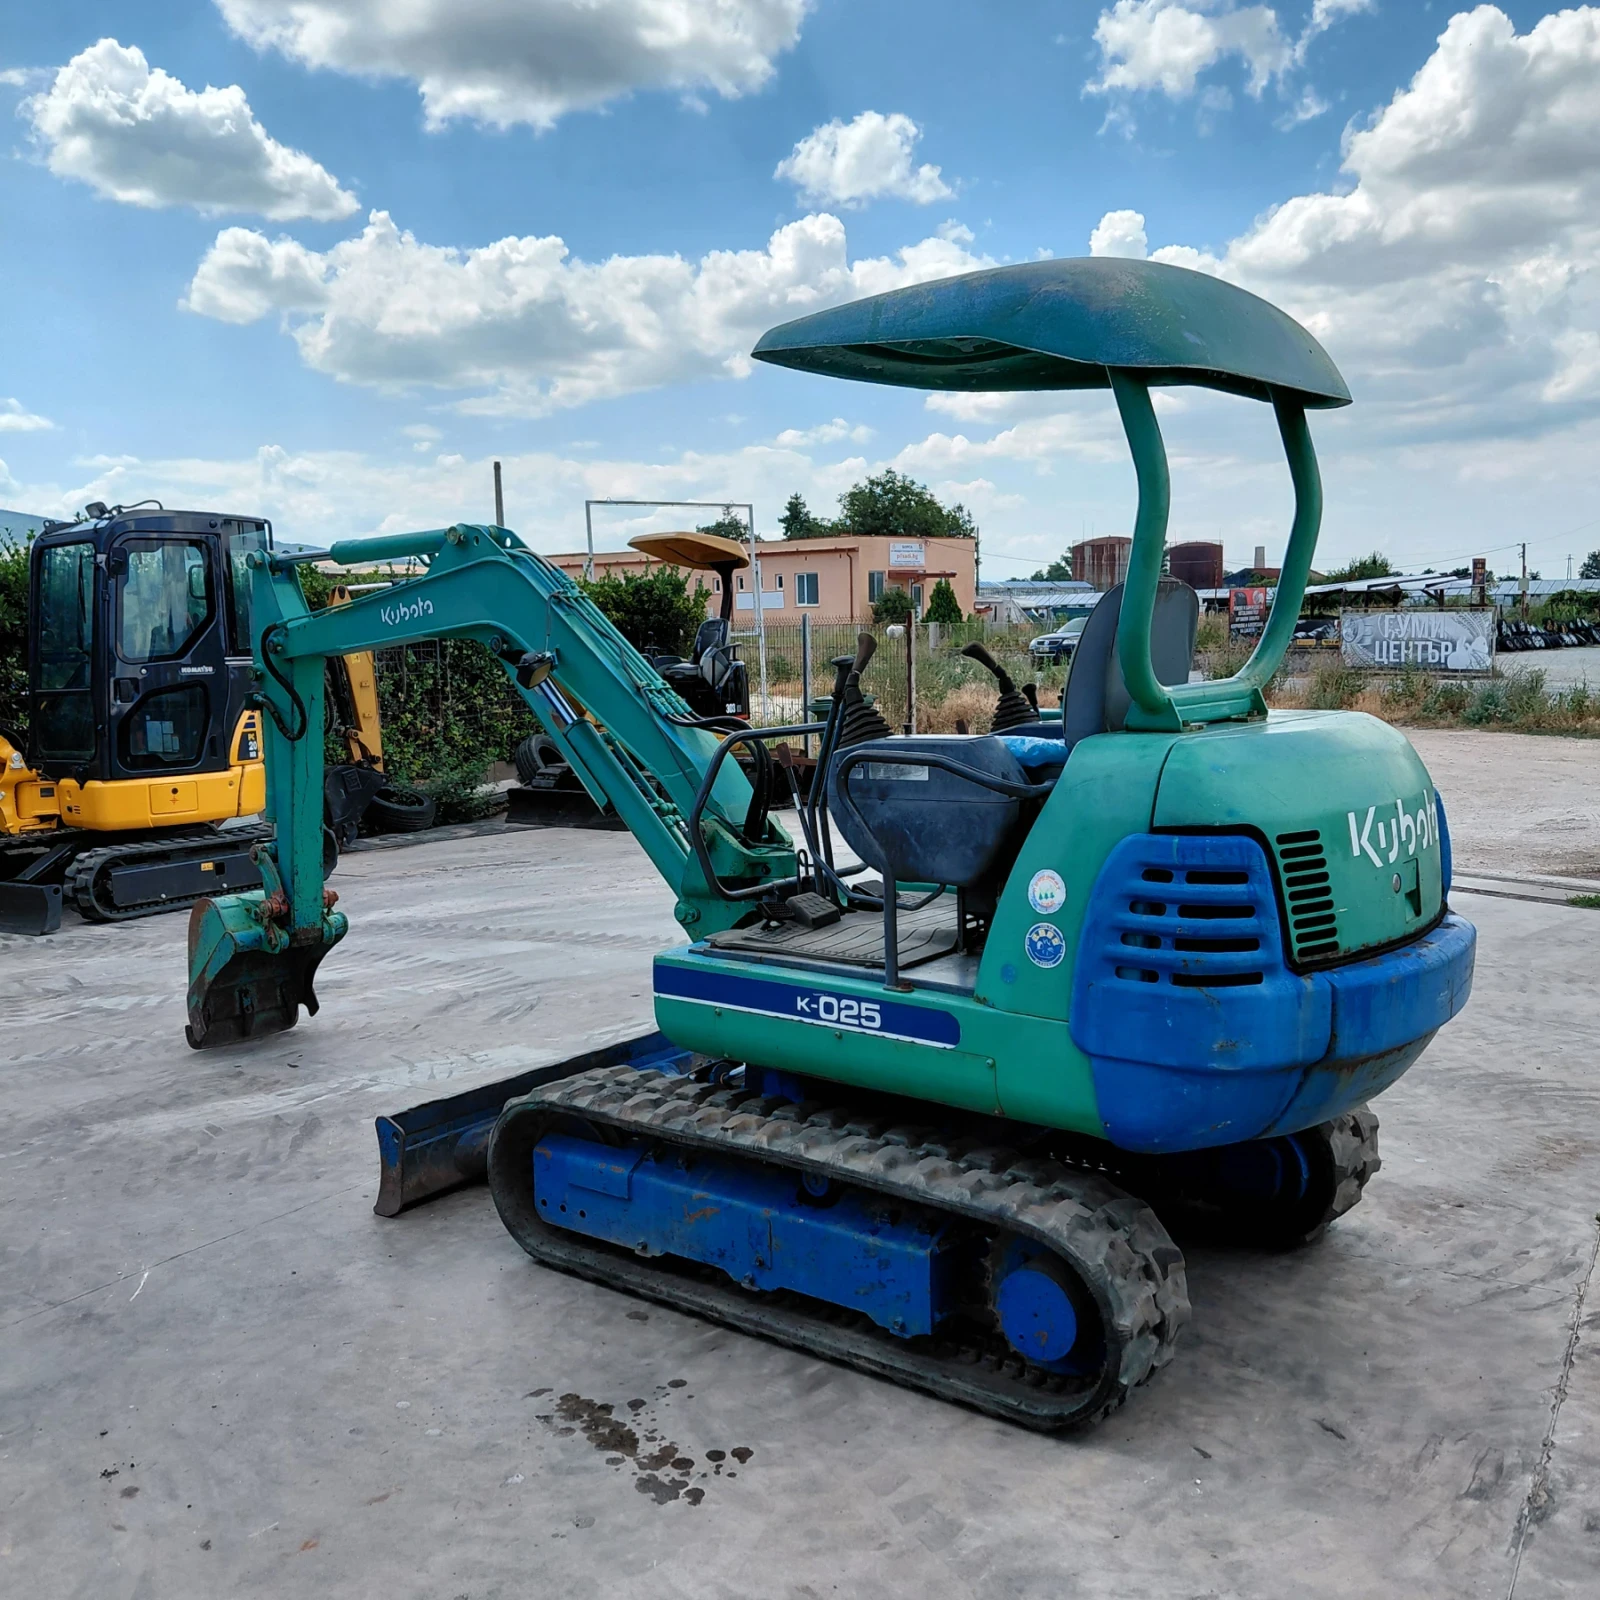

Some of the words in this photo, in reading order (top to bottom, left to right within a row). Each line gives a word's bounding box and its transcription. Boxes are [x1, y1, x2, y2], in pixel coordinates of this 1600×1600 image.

[380, 596, 434, 626] Kubota
[1384, 614, 1445, 639] ГУМИ
[1374, 640, 1453, 665] ЦЕНТЪР
[181, 665, 213, 673] KOMATSU
[725, 703, 736, 714] 303
[248, 740, 258, 751] 20
[1346, 788, 1440, 869] Kubota
[796, 995, 882, 1029] K-025
